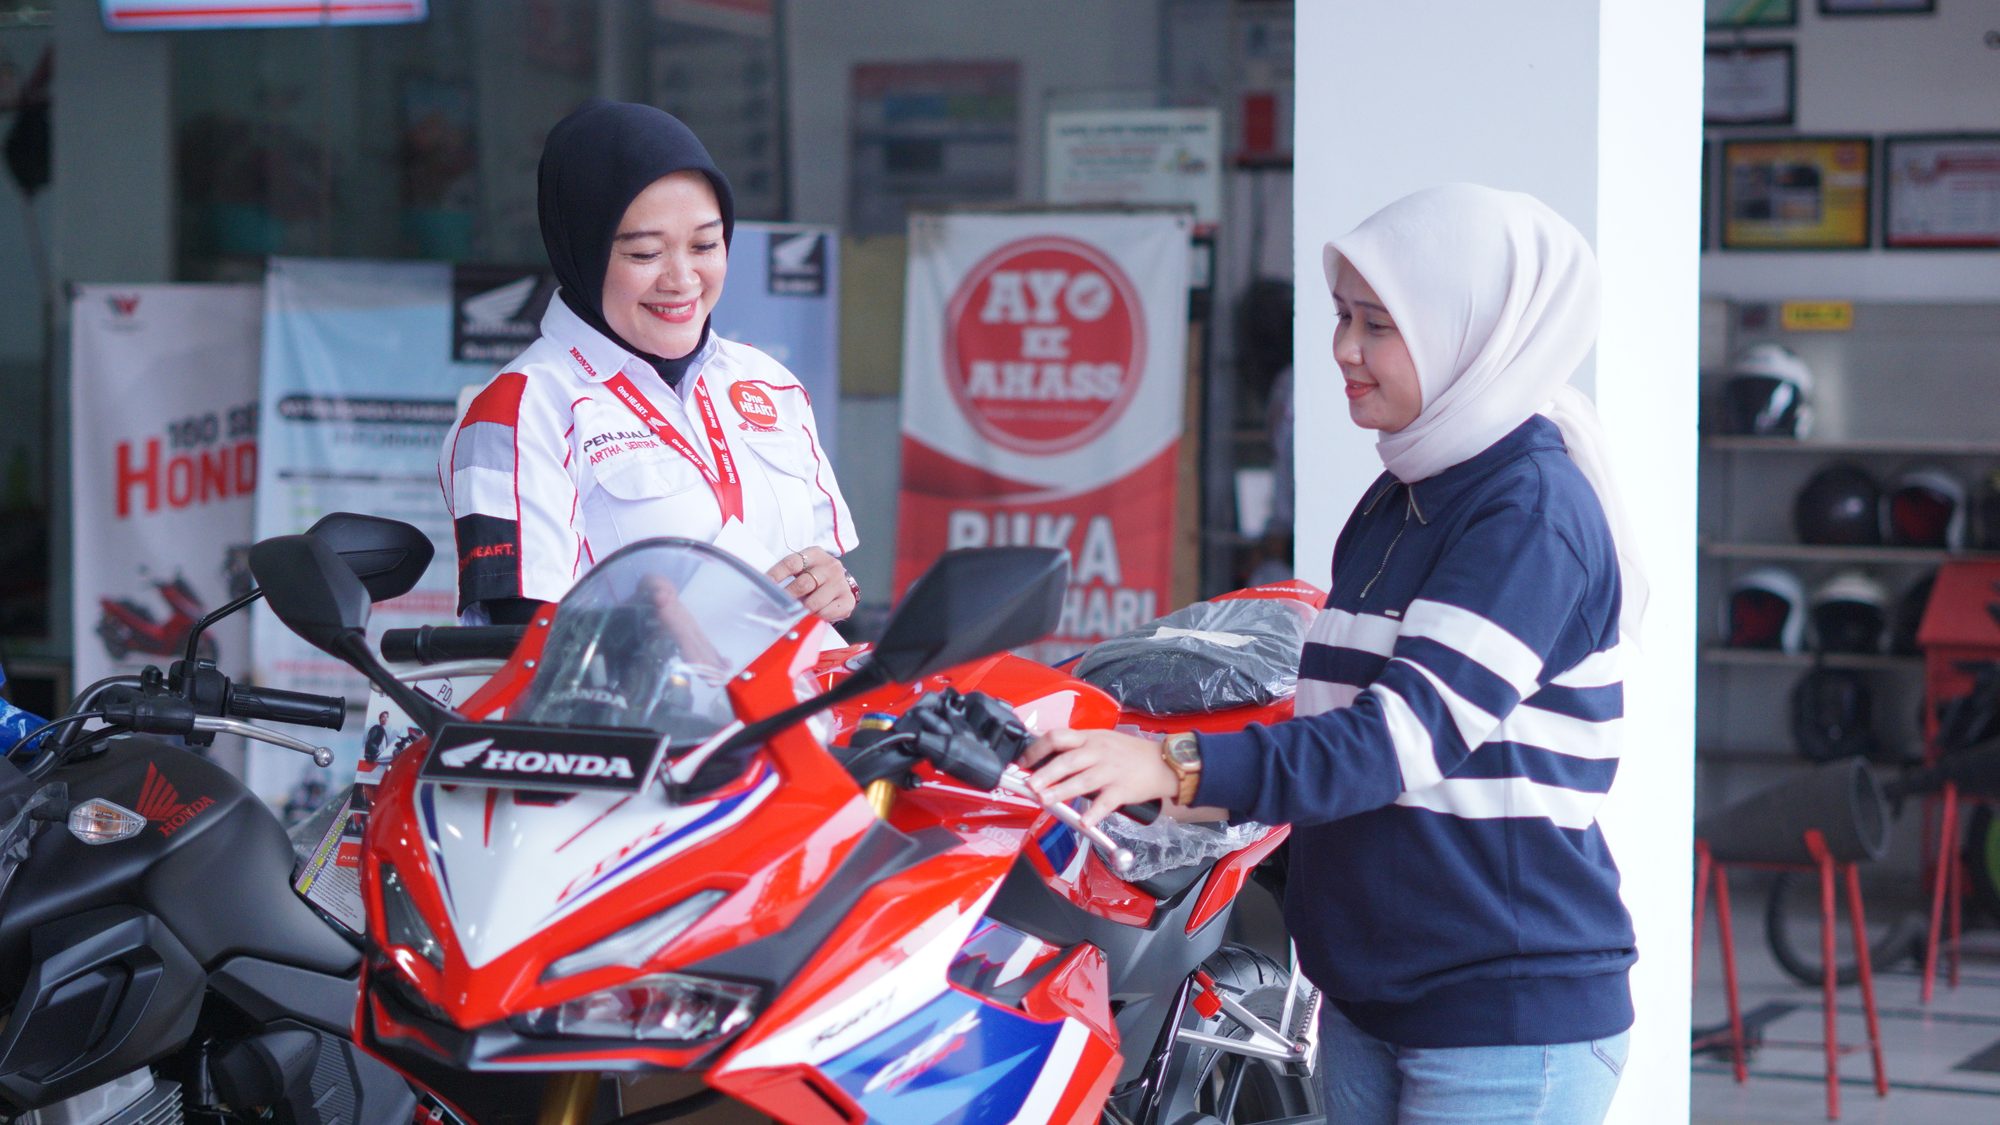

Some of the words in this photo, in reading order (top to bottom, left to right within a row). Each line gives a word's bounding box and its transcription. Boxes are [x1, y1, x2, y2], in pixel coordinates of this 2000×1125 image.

[980, 268, 1113, 323] AYO
[569, 346, 597, 377] HONDA
[616, 385, 629, 399] One
[966, 360, 1123, 401] AHASS
[741, 390, 765, 405] One
[227, 402, 259, 437] SE
[589, 443, 625, 466] ARTHA
[116, 438, 259, 518] HOND
[482, 749, 635, 779] HONDA
[158, 795, 217, 838] HONDA
